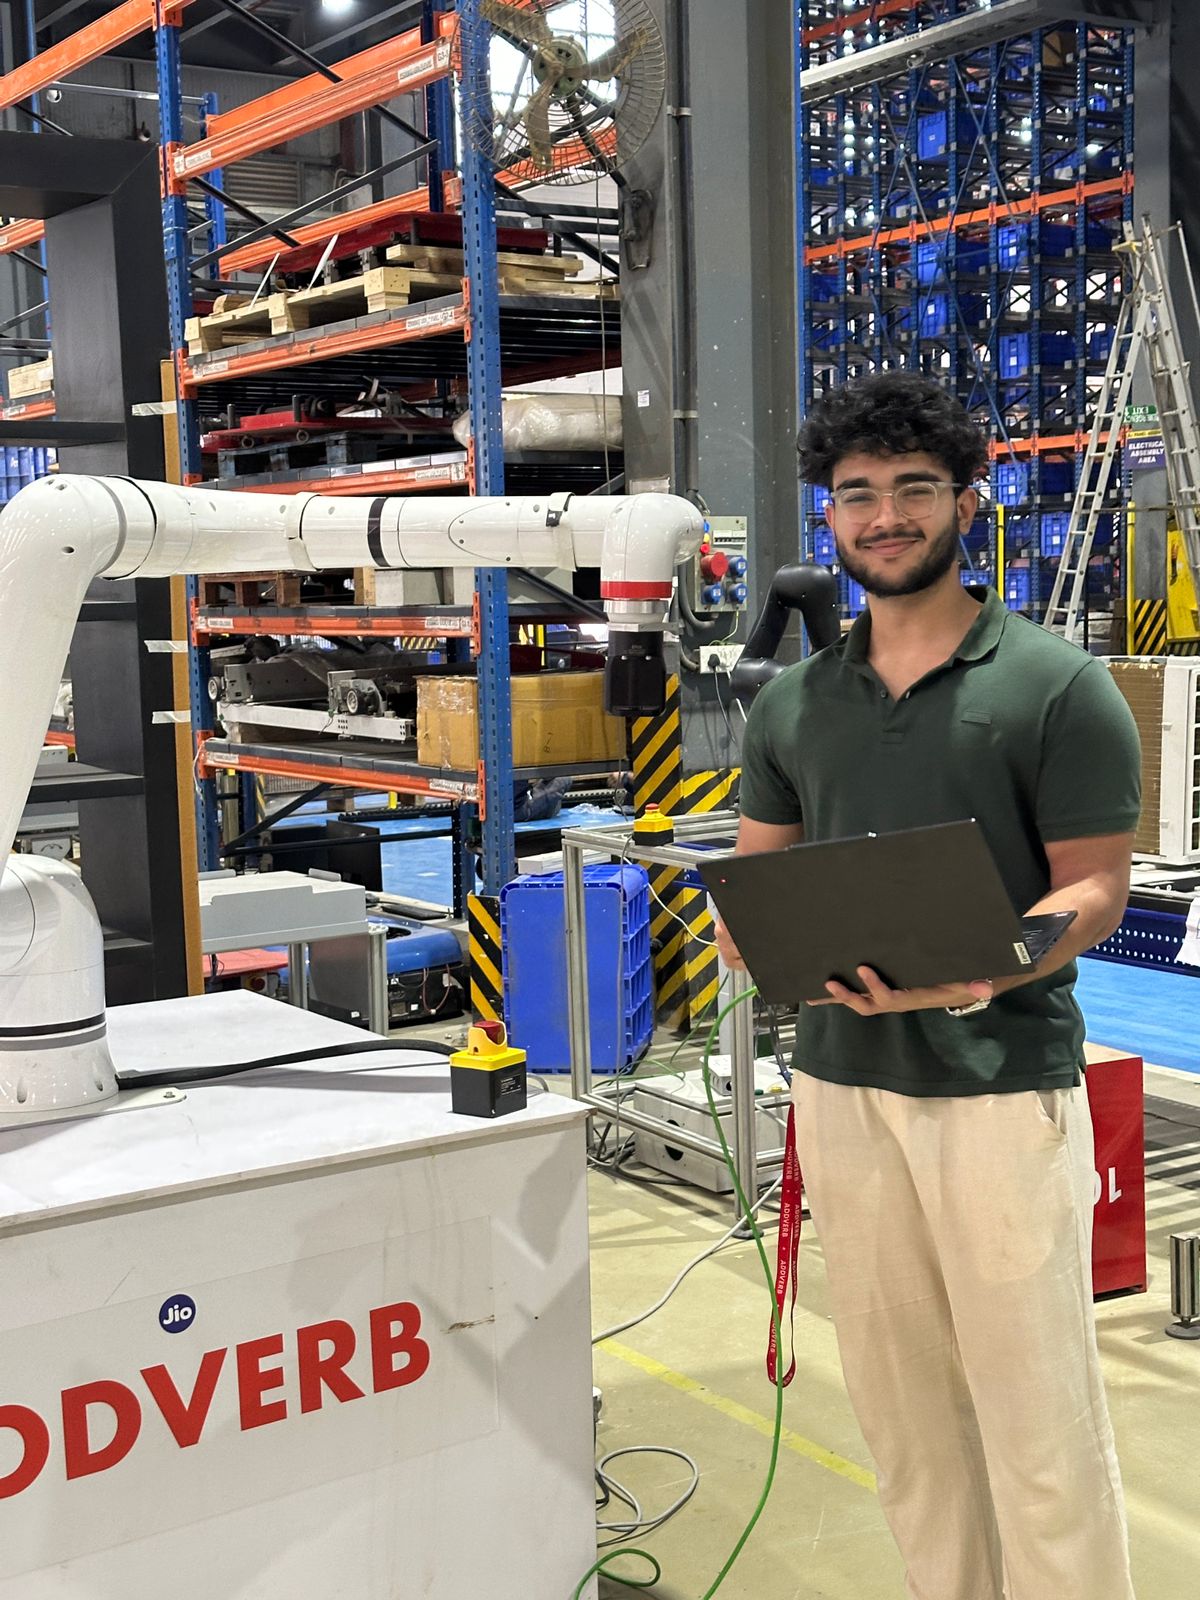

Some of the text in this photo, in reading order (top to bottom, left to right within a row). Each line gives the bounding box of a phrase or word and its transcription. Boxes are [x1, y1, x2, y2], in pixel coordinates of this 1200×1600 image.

[1129, 441, 1164, 449] ELECTRICA
[1130, 448, 1164, 457] ASSEMBLY
[1138, 456, 1156, 464] AREA
[782, 1202, 791, 1238] ADDVERB
[777, 1260, 787, 1294] ADDVERB
[163, 1304, 193, 1325] Jio
